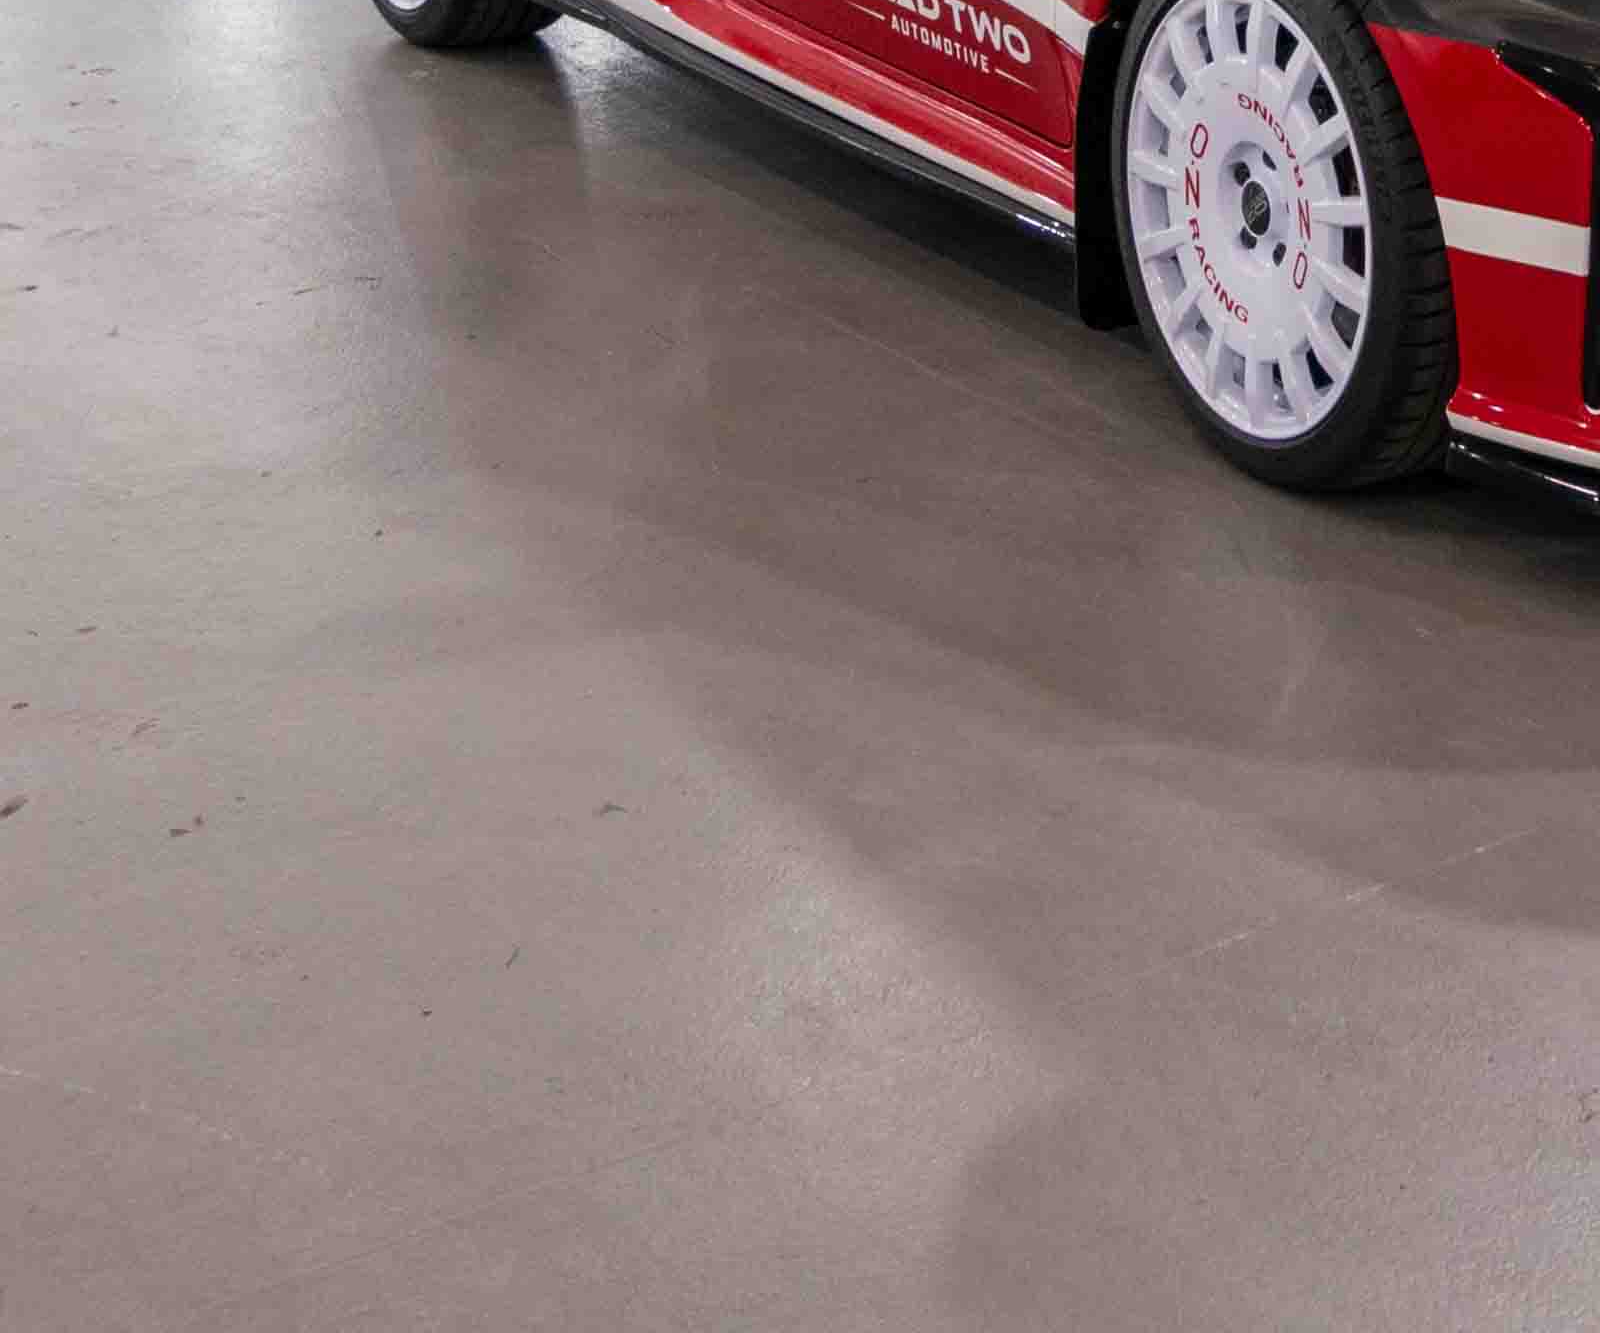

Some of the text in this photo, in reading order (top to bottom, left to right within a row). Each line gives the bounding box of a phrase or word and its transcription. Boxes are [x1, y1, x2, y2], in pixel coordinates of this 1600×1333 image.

[890, 13, 990, 74] AUTOMOTIVE
[1237, 92, 1306, 188] RACING
[1188, 217, 1249, 325] RACING
